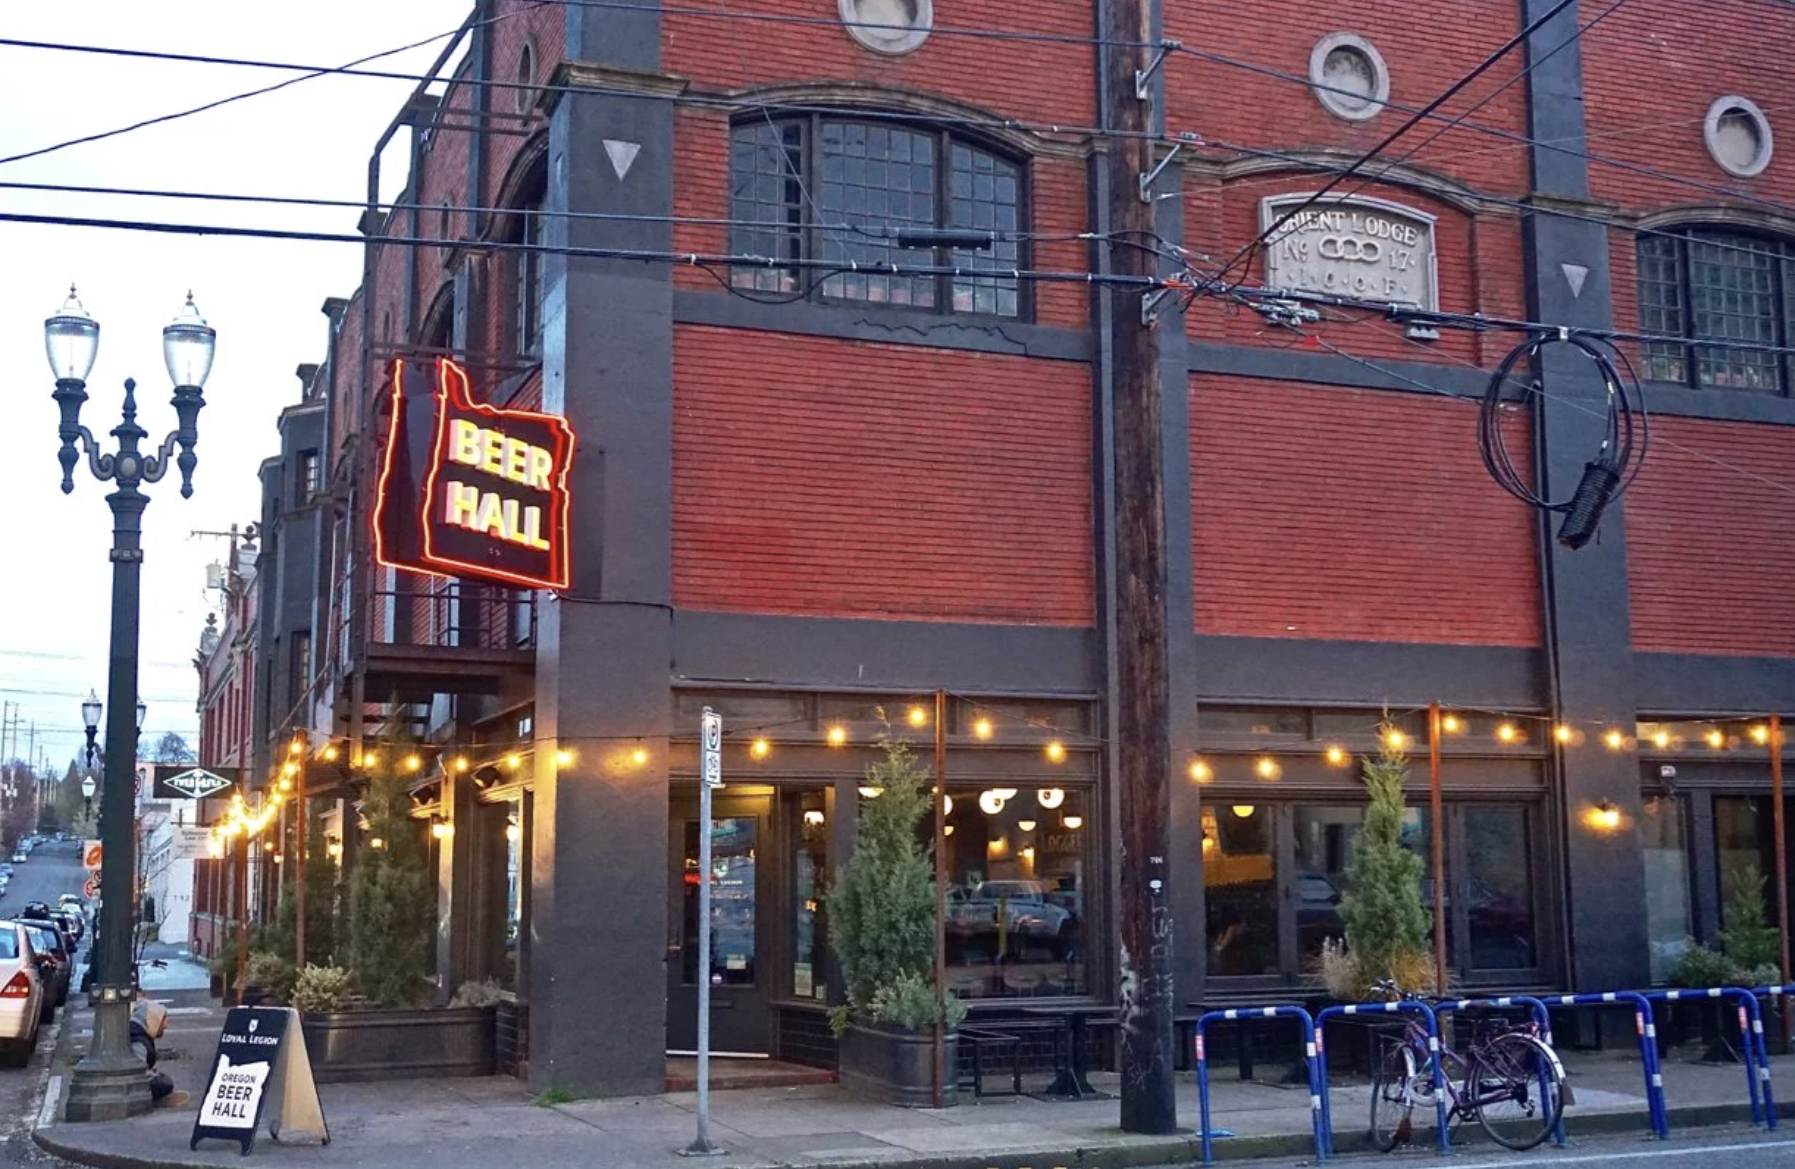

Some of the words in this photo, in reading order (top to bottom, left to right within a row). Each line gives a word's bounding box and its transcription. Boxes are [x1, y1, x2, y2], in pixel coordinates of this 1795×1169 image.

[1351, 212, 1418, 246] LODGE
[448, 418, 553, 492] BEER
[445, 480, 550, 551] HALL
[221, 1033, 247, 1043] LOYAL
[249, 1035, 279, 1045] LEGION
[221, 1072, 257, 1085] OREGON
[217, 1084, 253, 1101] BEER
[212, 1101, 247, 1119] HALL
